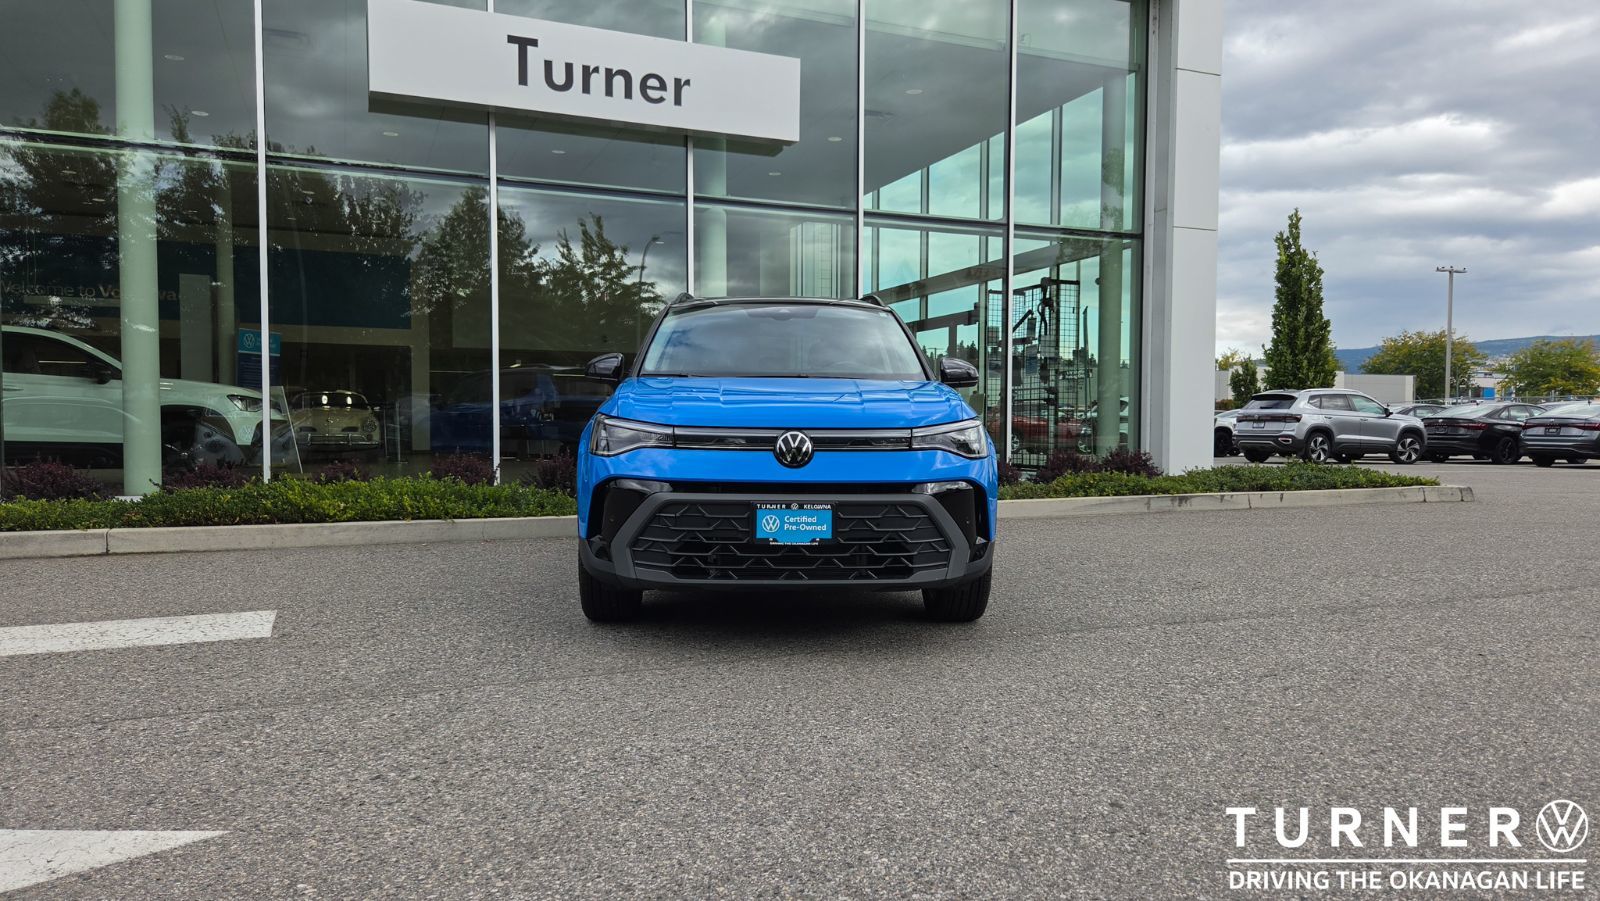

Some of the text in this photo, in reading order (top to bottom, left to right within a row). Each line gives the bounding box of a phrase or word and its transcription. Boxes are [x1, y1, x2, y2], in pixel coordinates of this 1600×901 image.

[507, 34, 691, 107] Turner
[784, 515, 817, 523] Certified
[784, 523, 827, 531] Pre-Owned
